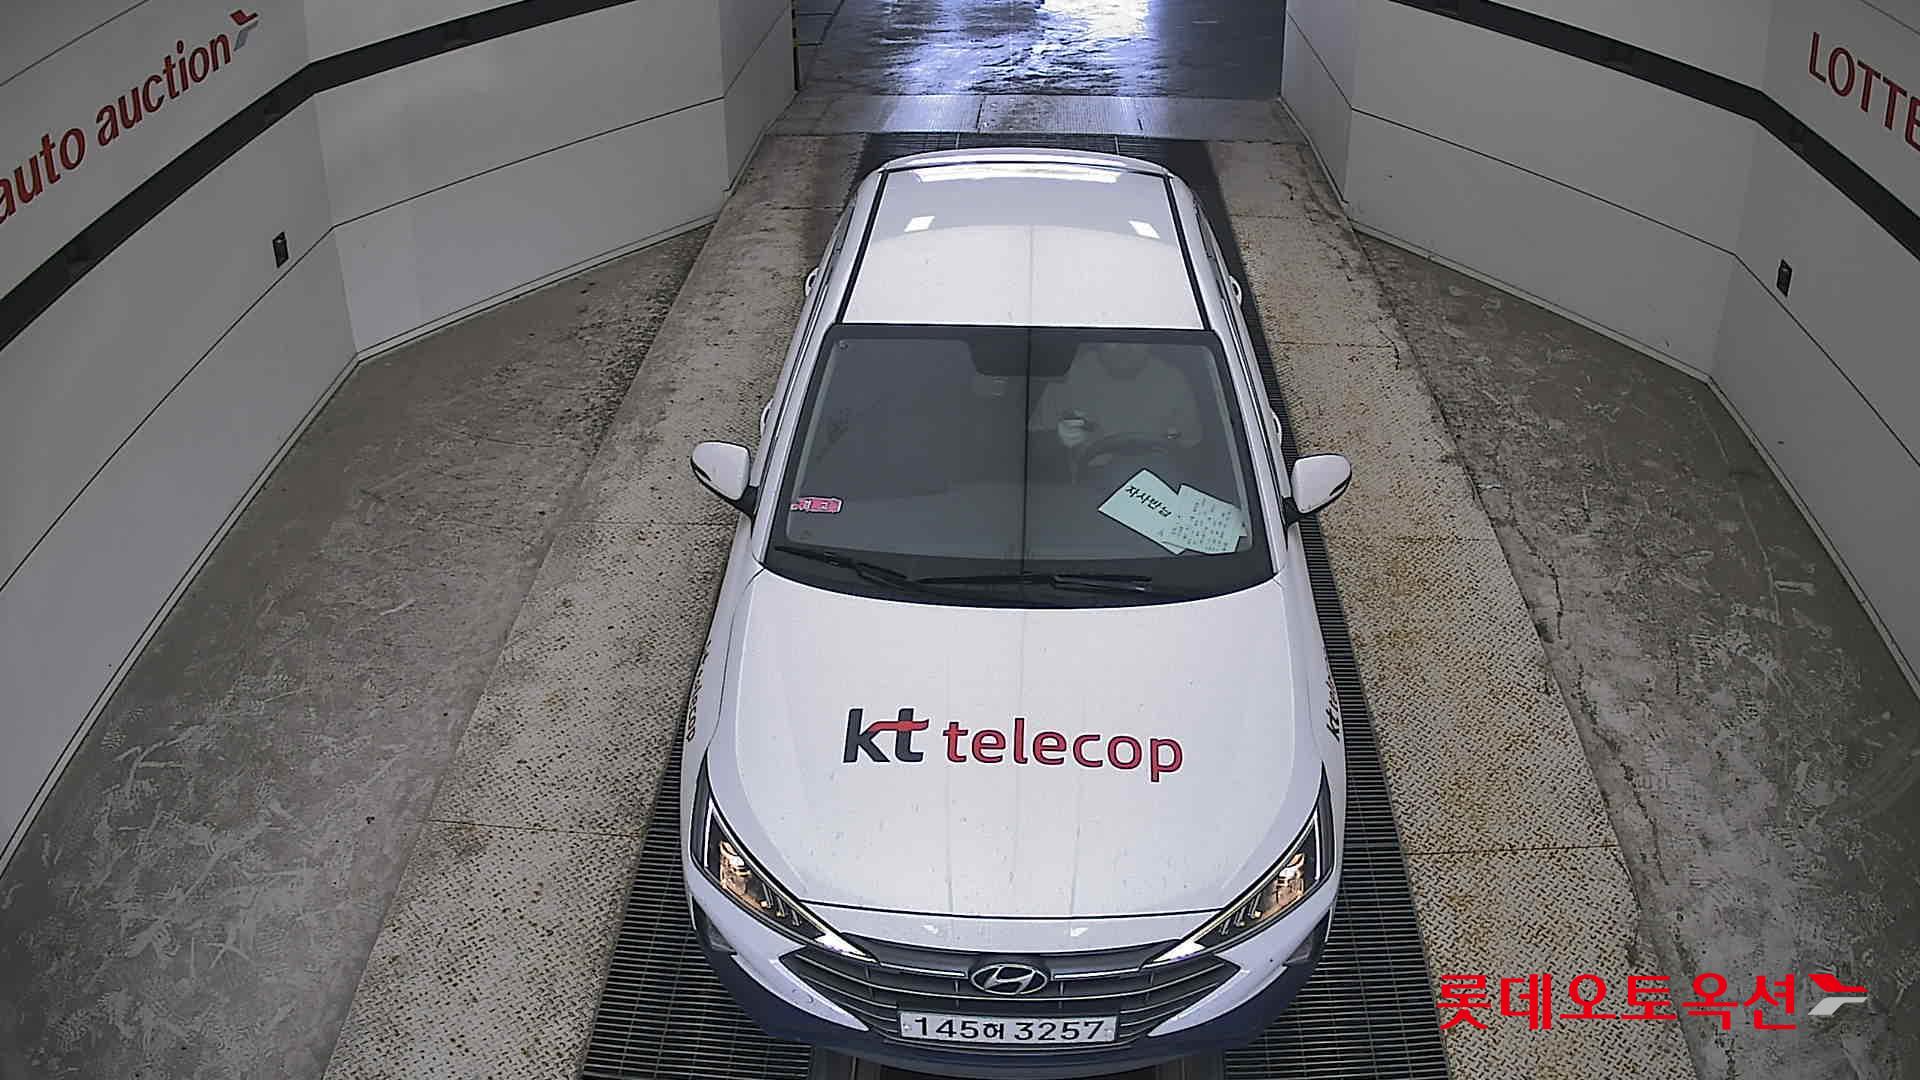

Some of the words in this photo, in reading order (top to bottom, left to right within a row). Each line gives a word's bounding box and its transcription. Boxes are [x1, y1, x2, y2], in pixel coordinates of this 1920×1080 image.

[0, 128, 86, 224] auto
[96, 34, 231, 146] auction
[1809, 31, 1920, 153] LOTTE
[843, 708, 930, 763] kt
[943, 718, 1184, 783] telecop
[1014, 1019, 1105, 1042] 3257
